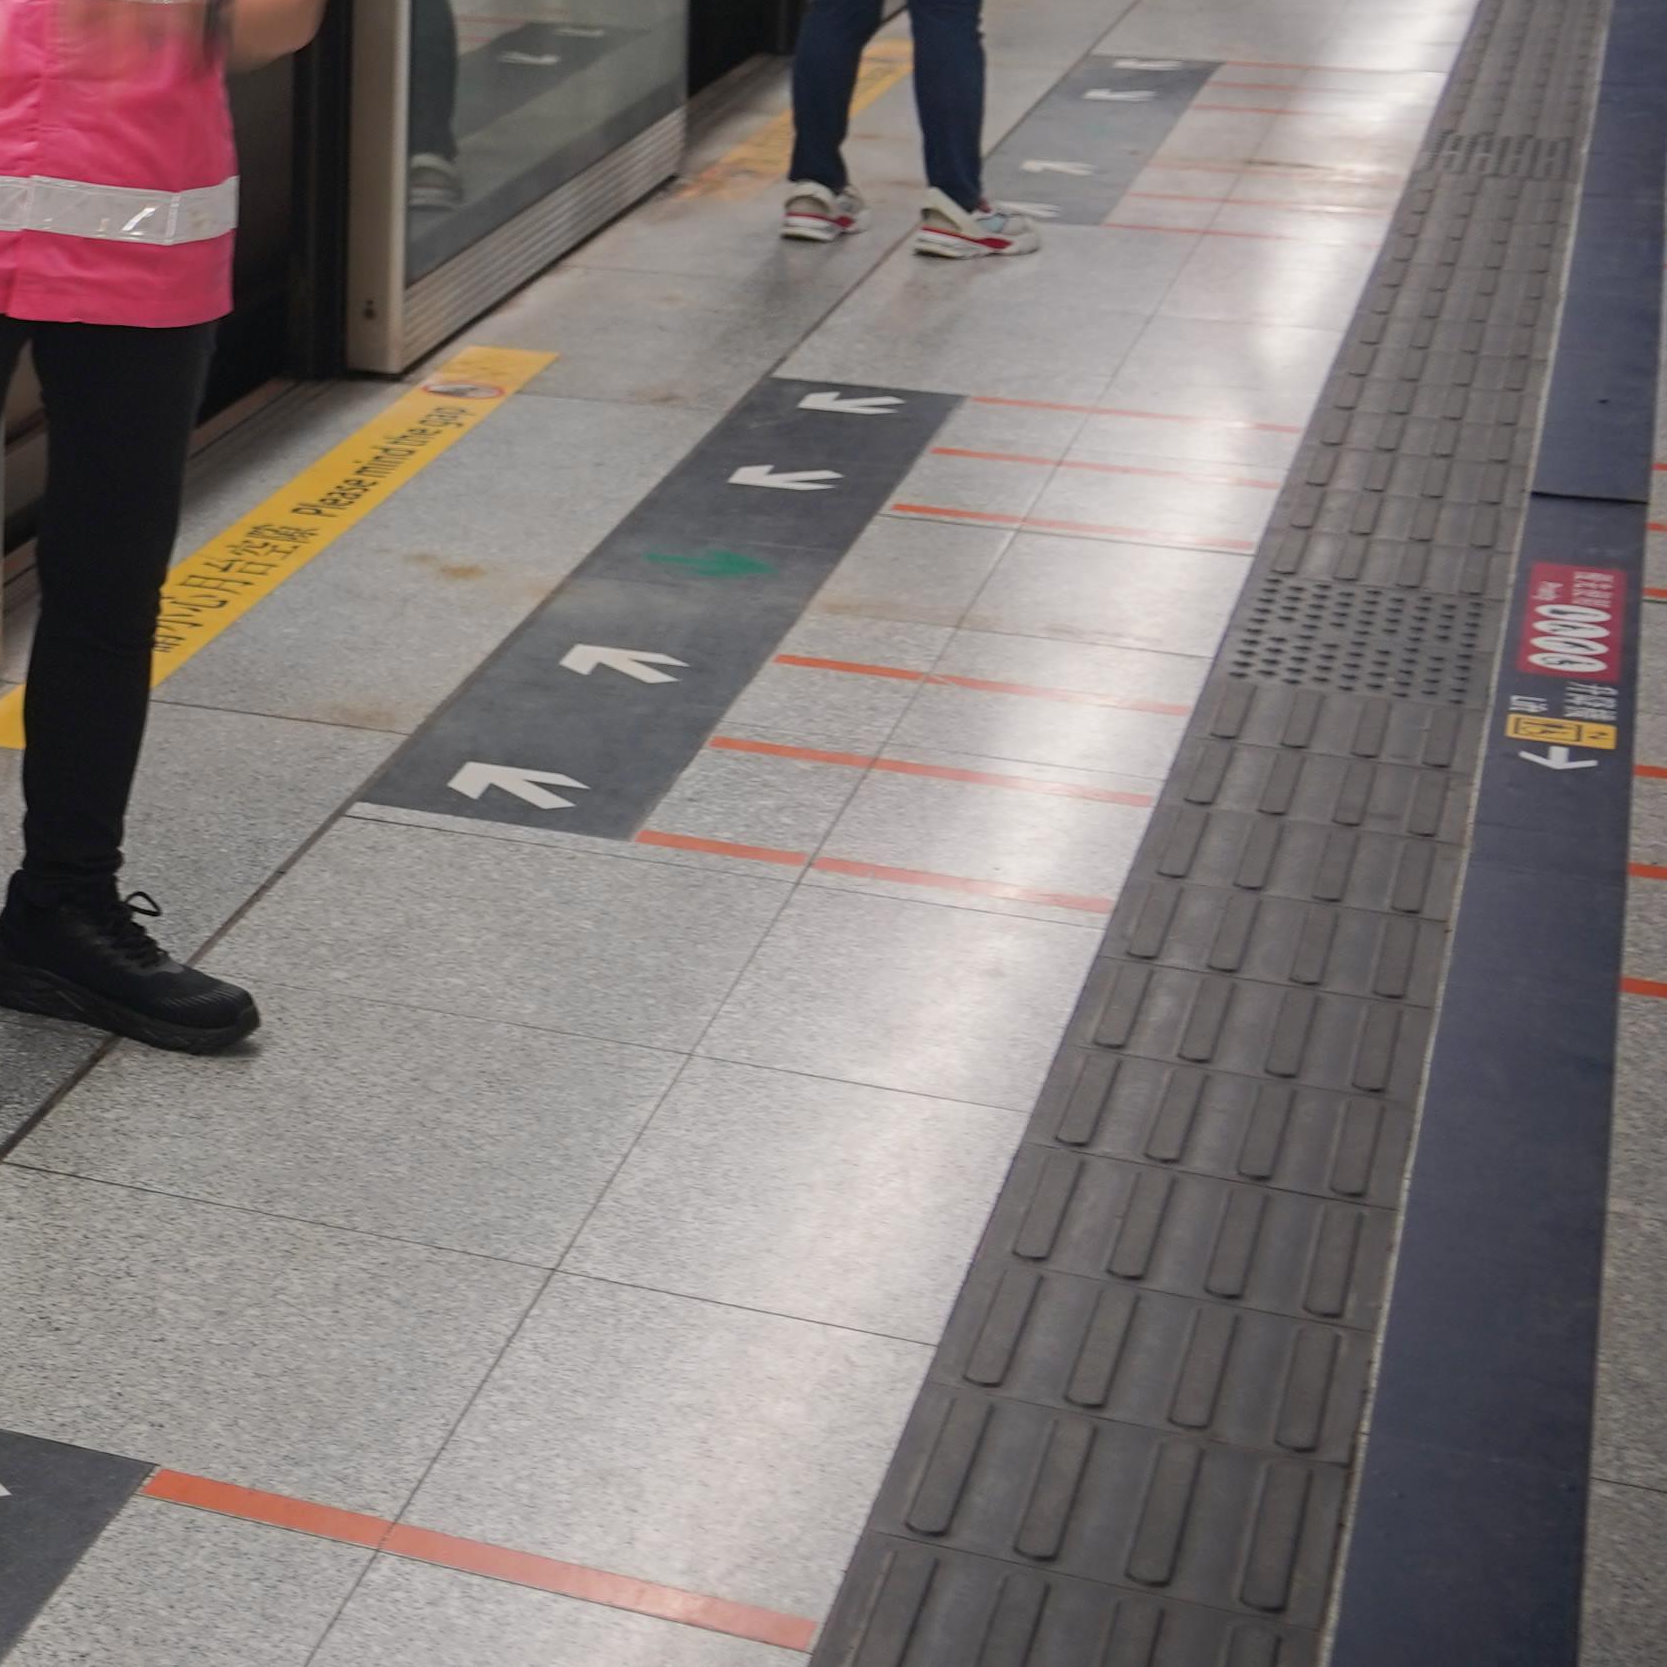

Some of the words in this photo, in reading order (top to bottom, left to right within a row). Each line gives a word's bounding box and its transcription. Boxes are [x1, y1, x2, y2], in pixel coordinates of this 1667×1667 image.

[419, 405, 475, 430] gap
[384, 427, 441, 449] the
[353, 444, 416, 479] mind
[291, 478, 379, 518] Please
[1509, 694, 1549, 714] Lift
